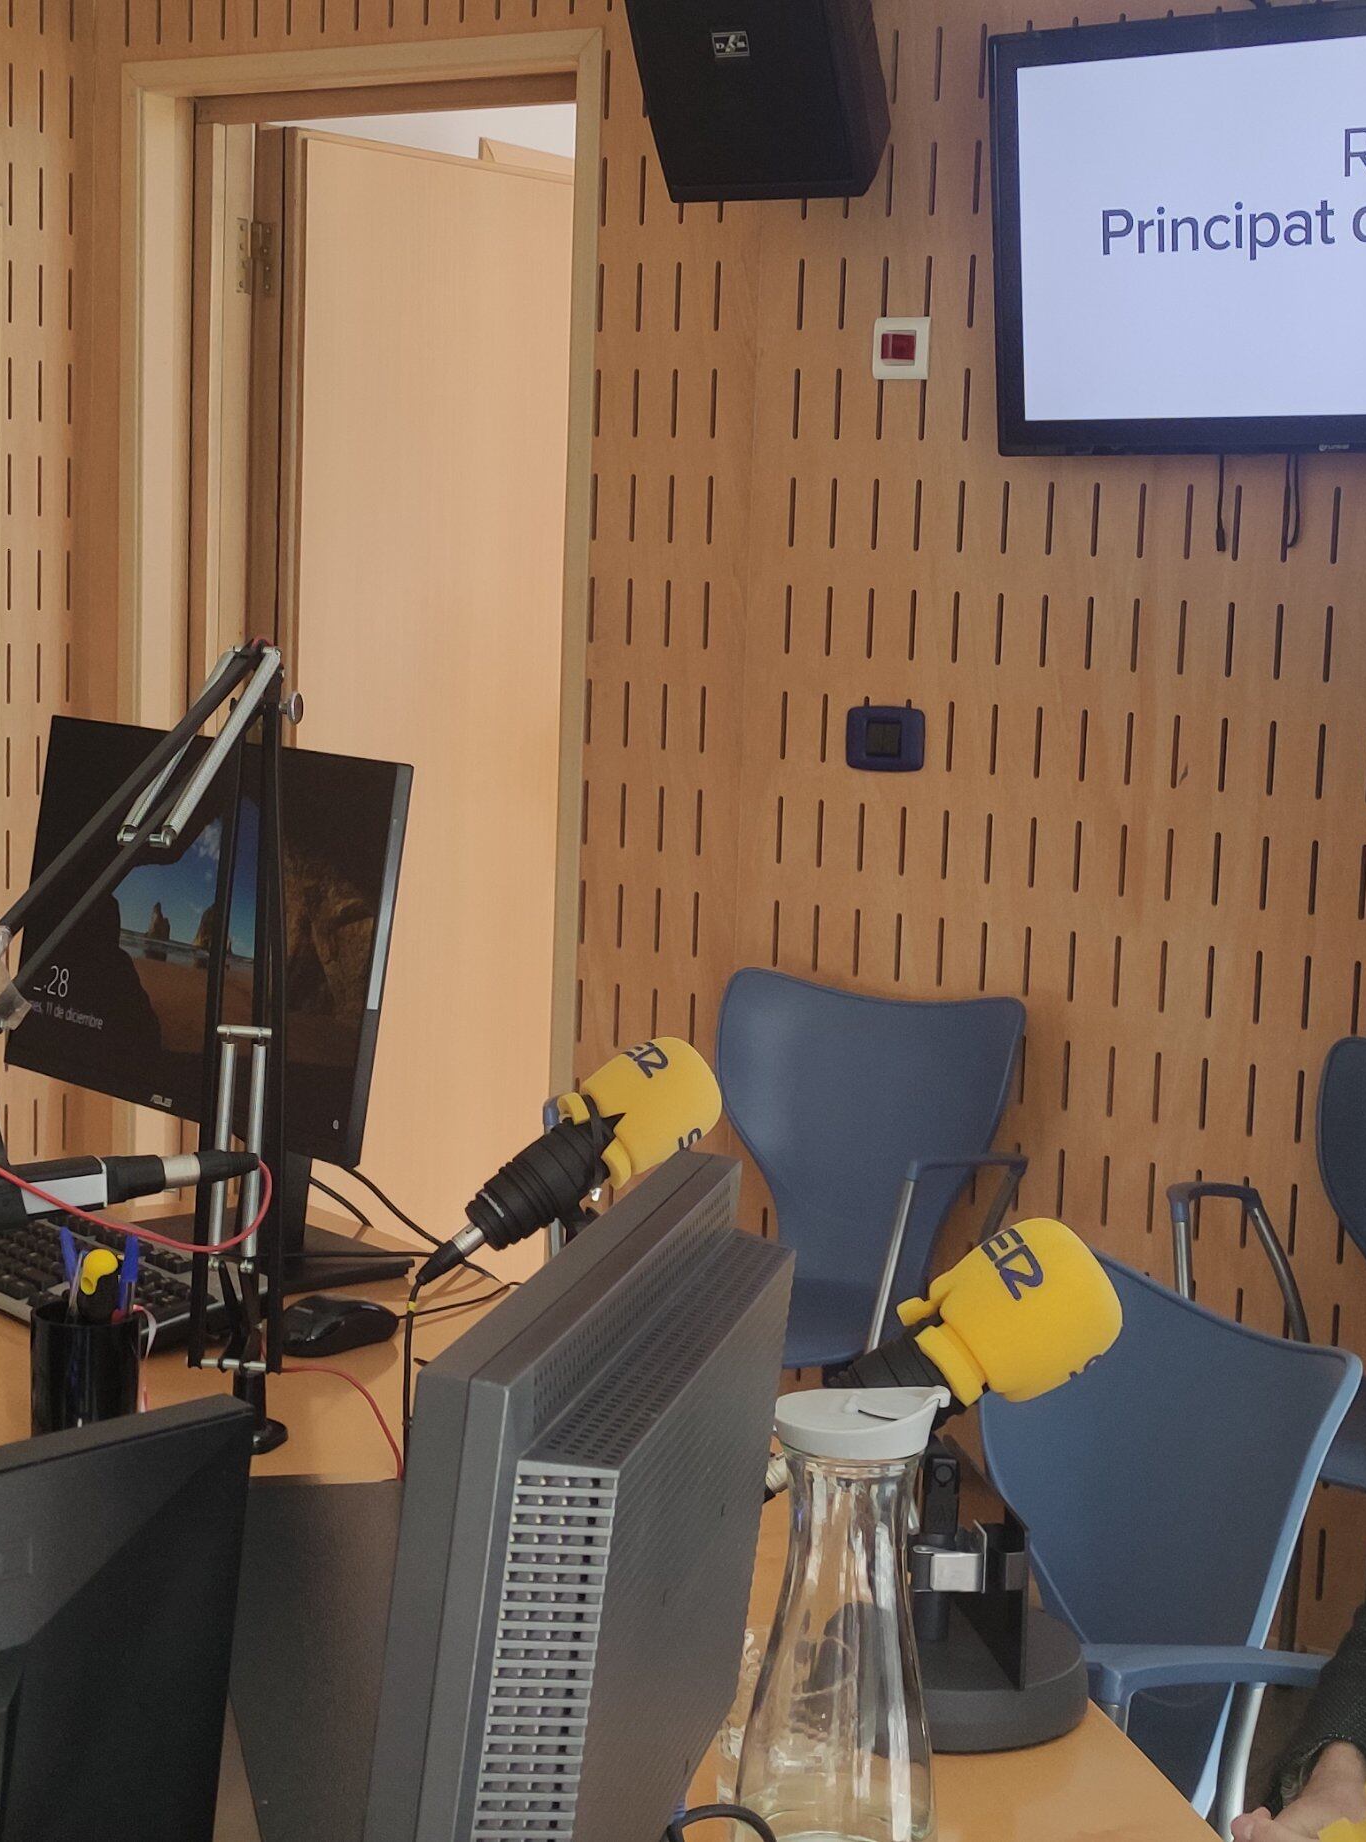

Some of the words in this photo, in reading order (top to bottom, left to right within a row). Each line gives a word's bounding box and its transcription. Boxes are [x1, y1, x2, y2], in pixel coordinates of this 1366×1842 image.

[1101, 199, 1336, 261] Principat
[623, 1041, 670, 1079] ER
[981, 1227, 1045, 1302] ER
